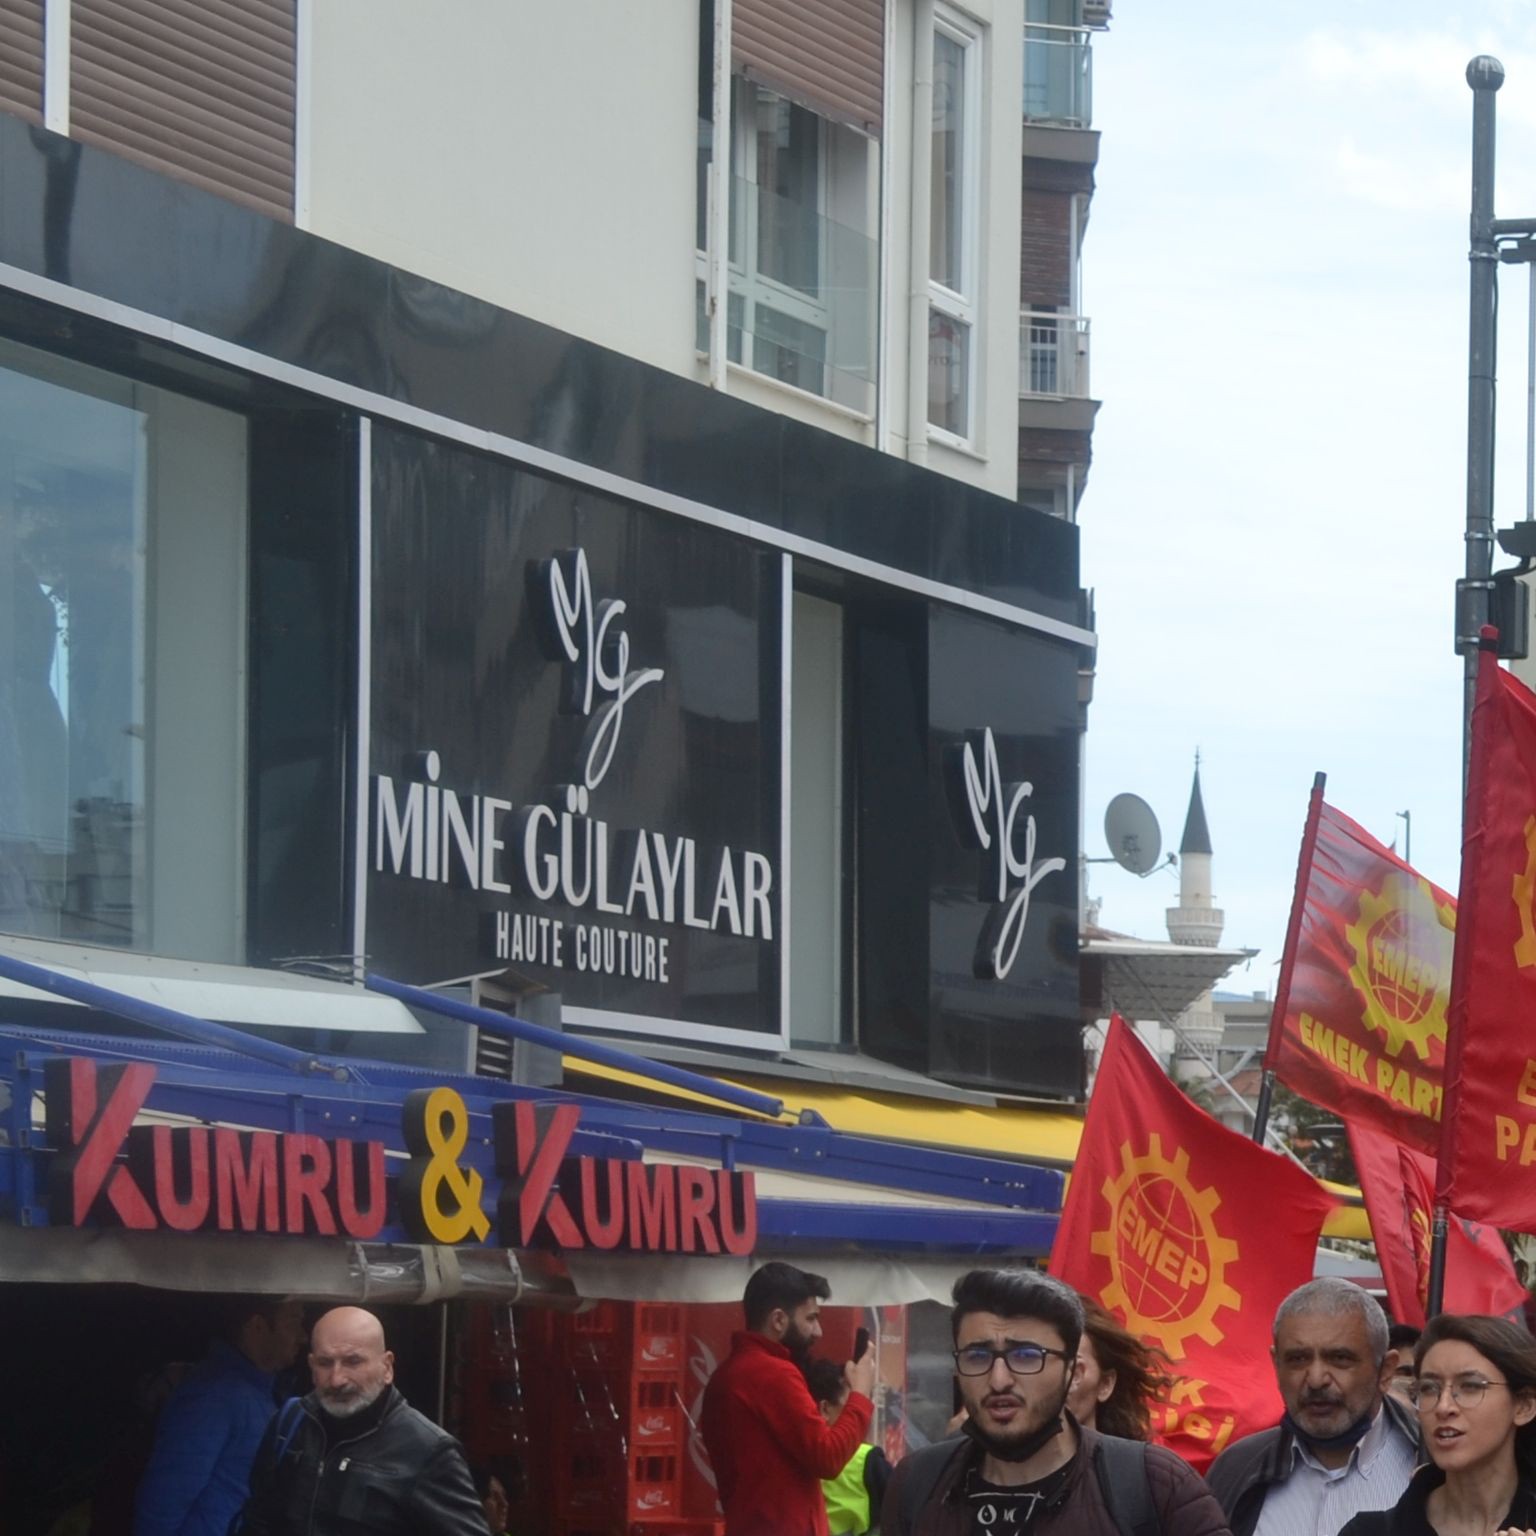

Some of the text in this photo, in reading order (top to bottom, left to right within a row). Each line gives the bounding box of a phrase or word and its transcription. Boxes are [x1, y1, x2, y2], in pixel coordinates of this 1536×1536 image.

[374, 750, 774, 943] MİNE GÜLAYLAR
[495, 910, 671, 984] HAUTE COUTURE
[1372, 935, 1440, 997] EMEP
[1299, 1010, 1443, 1123] EMEK PART
[70, 1056, 758, 1257] KUMRU & KUMRU
[1117, 1192, 1212, 1294] EMEP
